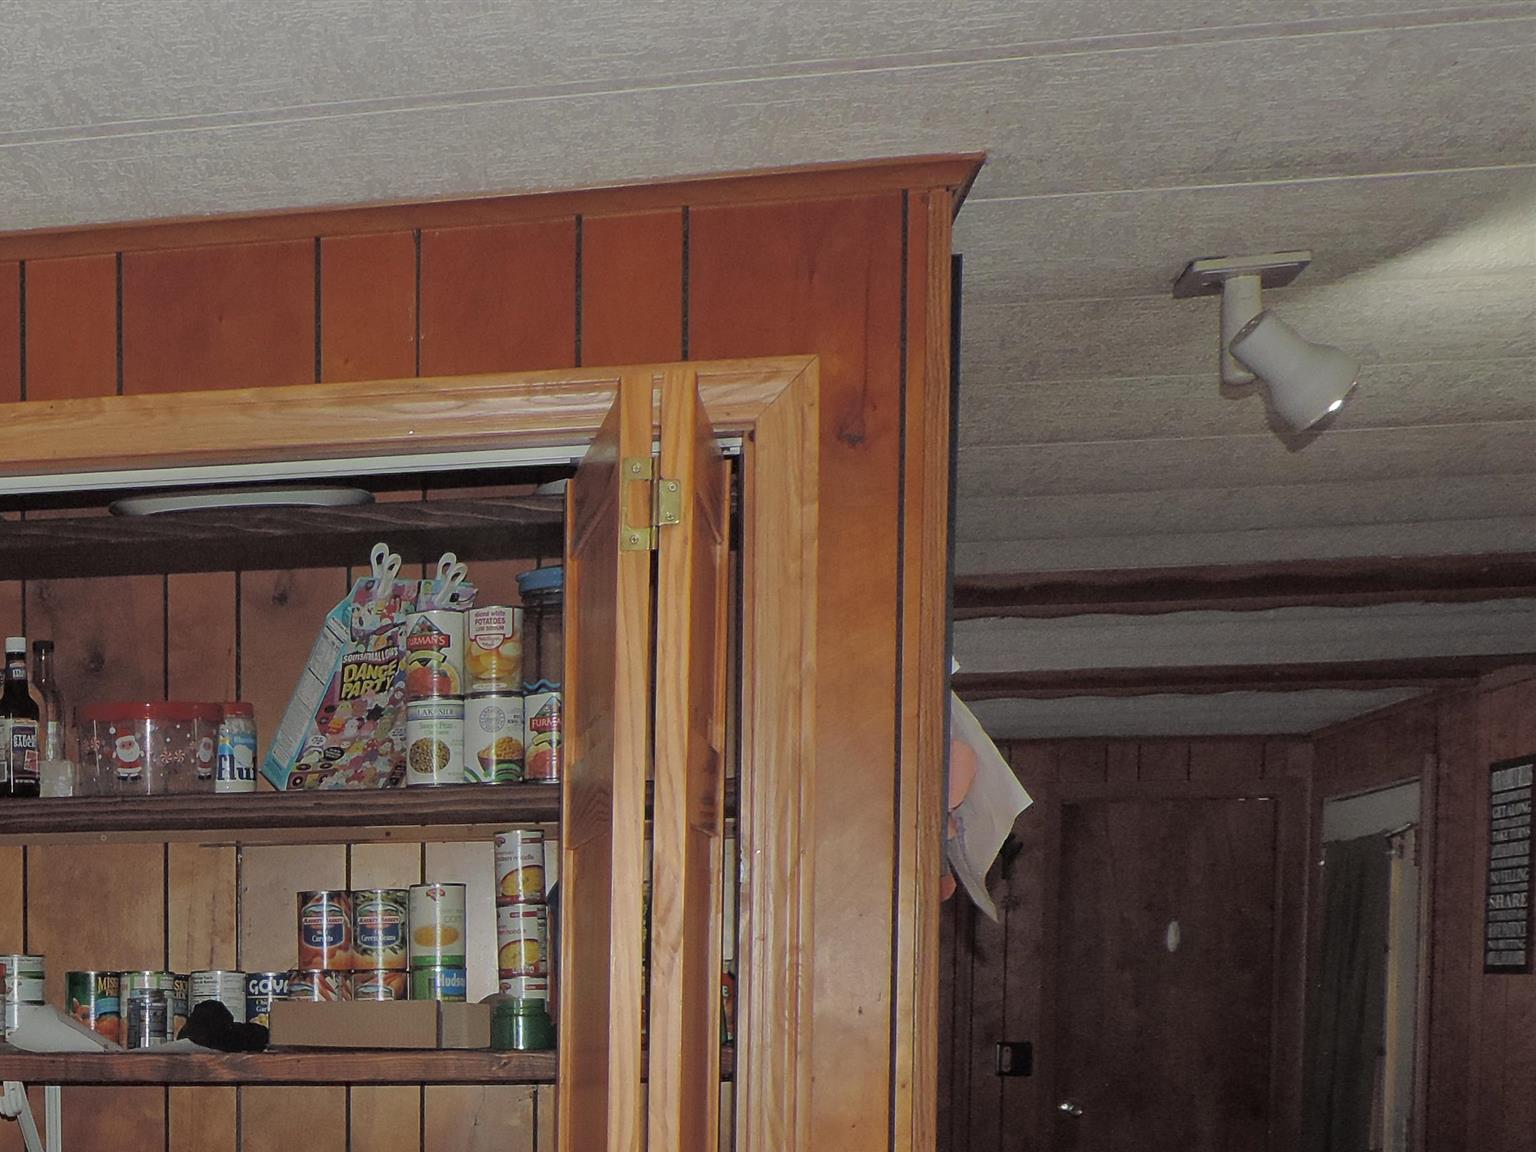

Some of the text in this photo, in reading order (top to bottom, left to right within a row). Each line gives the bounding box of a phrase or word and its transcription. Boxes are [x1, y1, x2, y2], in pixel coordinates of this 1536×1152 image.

[474, 618, 506, 626] POTATOES
[343, 658, 398, 684] DANCE
[341, 675, 395, 699] PARTY
[1489, 892, 1528, 909] SHARE
